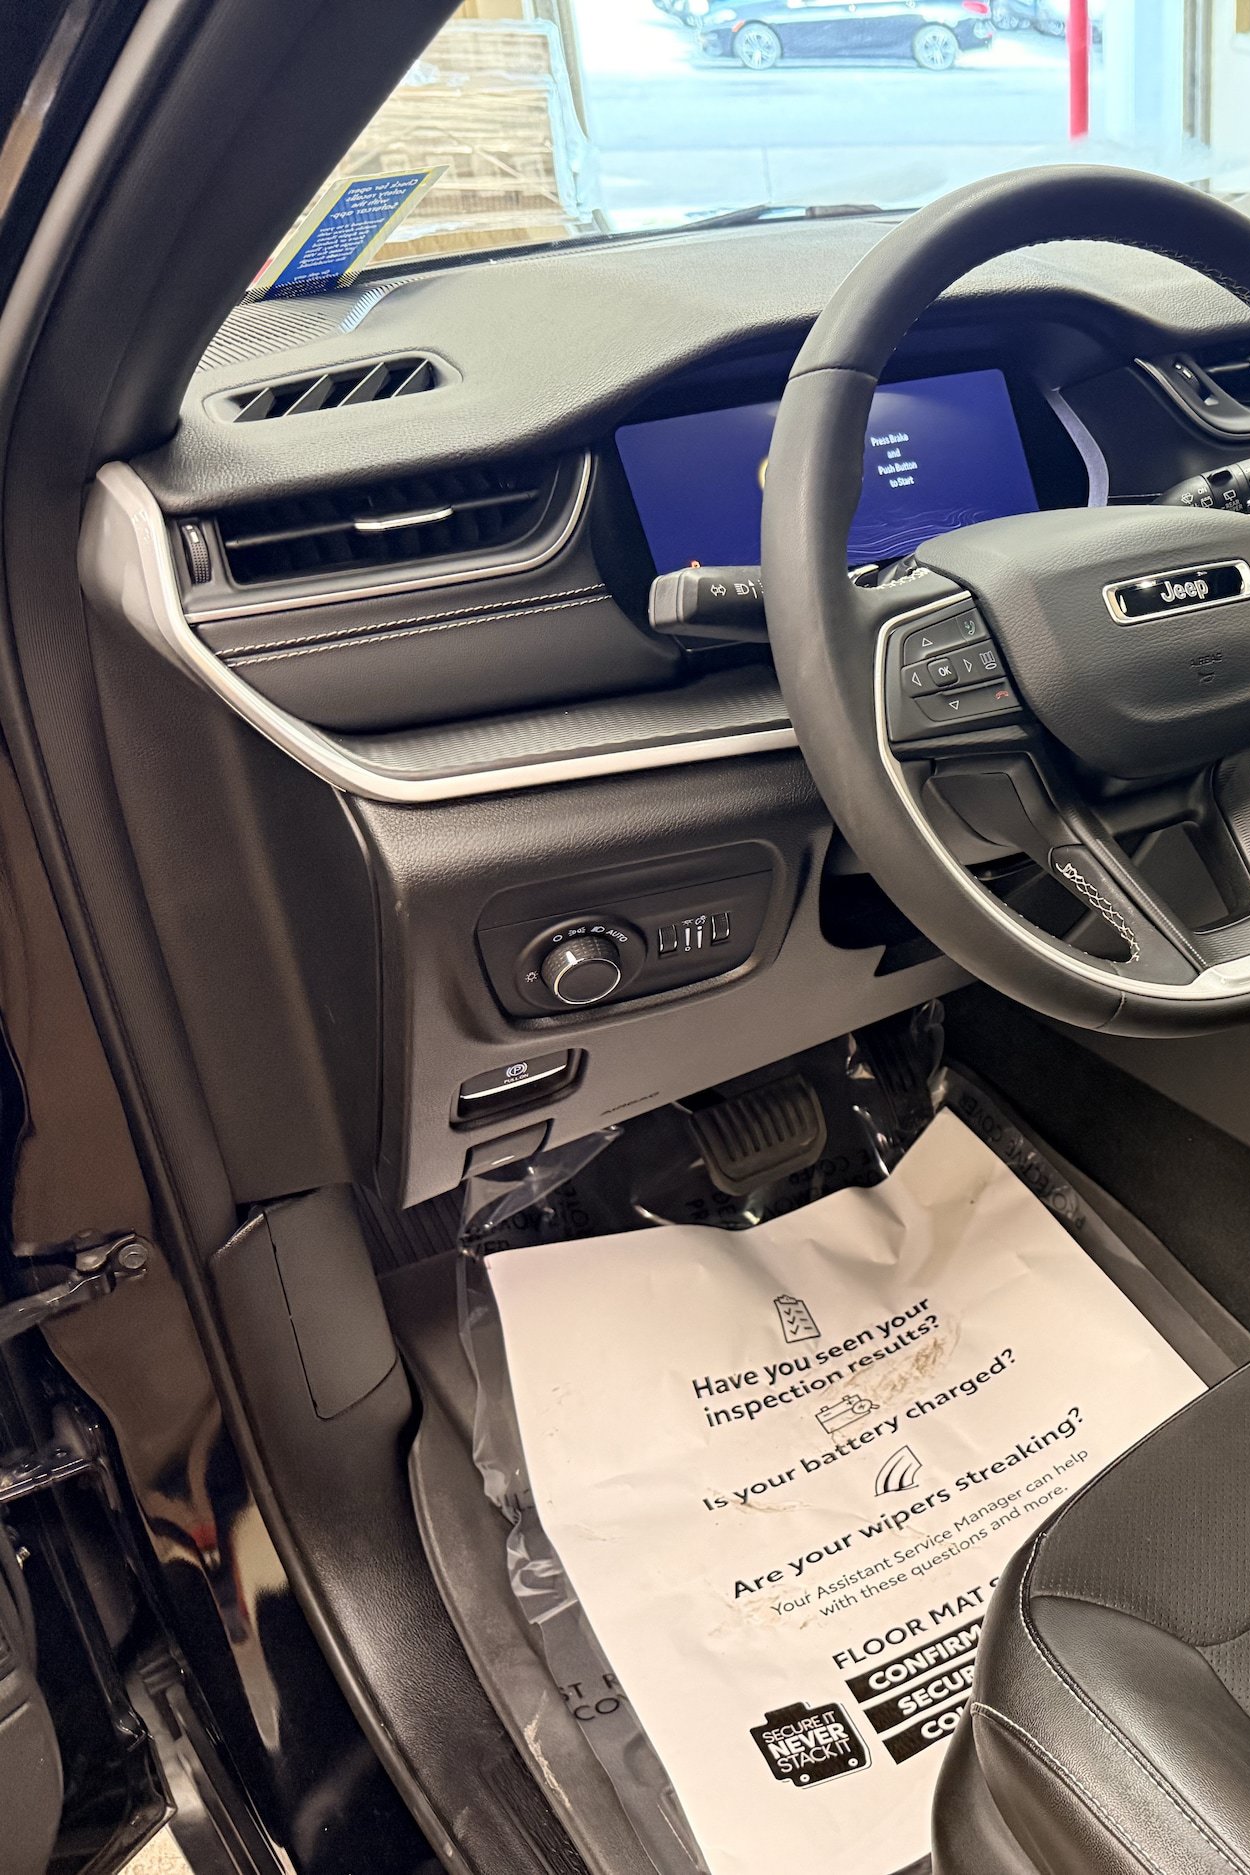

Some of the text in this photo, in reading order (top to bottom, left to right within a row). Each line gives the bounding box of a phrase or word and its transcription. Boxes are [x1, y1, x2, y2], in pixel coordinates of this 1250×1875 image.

[870, 432, 910, 447] Press Brake
[887, 447, 901, 459] and
[878, 461, 918, 476] Push Button
[889, 475, 915, 489] to Start
[1197, 486, 1208, 495] ON
[1160, 580, 1209, 603] Jeep
[938, 665, 952, 678] OK
[605, 929, 629, 943] AUTO
[692, 1298, 930, 1400] Have you seen your
[703, 1314, 940, 1427] inspection results?
[702, 1348, 1016, 1512] Is your battery charged?
[733, 1406, 1085, 1599] Are your wipers streaking?
[770, 1449, 1090, 1617] Your Assistant Service Manager can help
[819, 1484, 1069, 1617] with these questions and more.
[832, 1586, 987, 1670] FLOOR MAT
[868, 1623, 982, 1691] CONFIRM
[898, 1664, 975, 1716] SECUR
[762, 1710, 836, 1744] SECURE IT
[767, 1722, 849, 1760] NEVER
[777, 1737, 851, 1773] STACK IT
